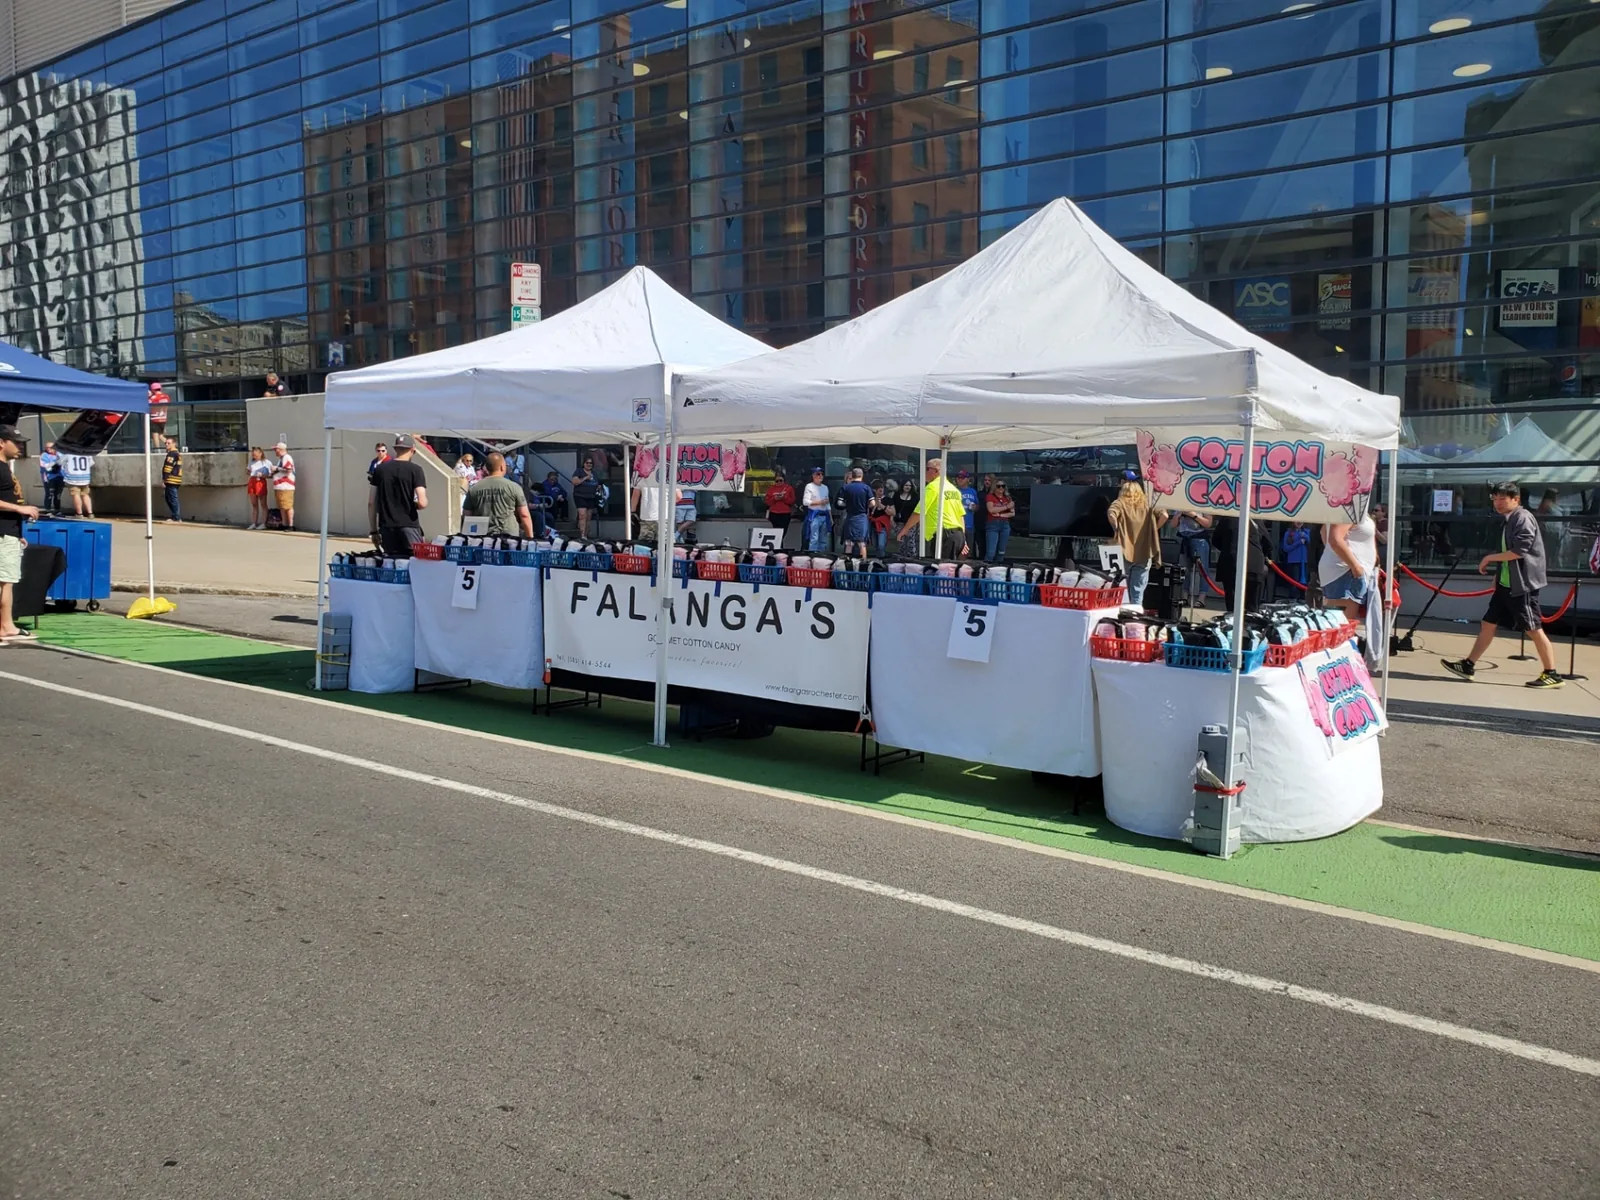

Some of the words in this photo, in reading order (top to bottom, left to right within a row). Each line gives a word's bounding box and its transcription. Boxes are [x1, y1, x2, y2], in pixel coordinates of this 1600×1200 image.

[854, 0, 868, 148] ARINE
[606, 166, 627, 268] FOR
[513, 266, 522, 275] NO
[1585, 272, 1600, 287] Inj
[1236, 282, 1288, 307] ASC
[513, 309, 521, 319] 15
[1525, 301, 1554, 311] YORK'S
[1502, 313, 1531, 321] LEADING
[1532, 312, 1555, 321] UNION
[72, 456, 87, 472] 10
[1177, 437, 1324, 479] COTTON
[656, 464, 718, 487] NDY
[1185, 474, 1313, 517] CANDY
[759, 532, 776, 549] $5
[1104, 551, 1120, 573] $5
[461, 566, 475, 591] $5
[962, 604, 988, 637] $5
[647, 633, 681, 645] GOMET
[682, 637, 713, 649] COTTON
[714, 641, 741, 652] CANDY
[764, 683, 860, 702] www.faangasrochester.com
